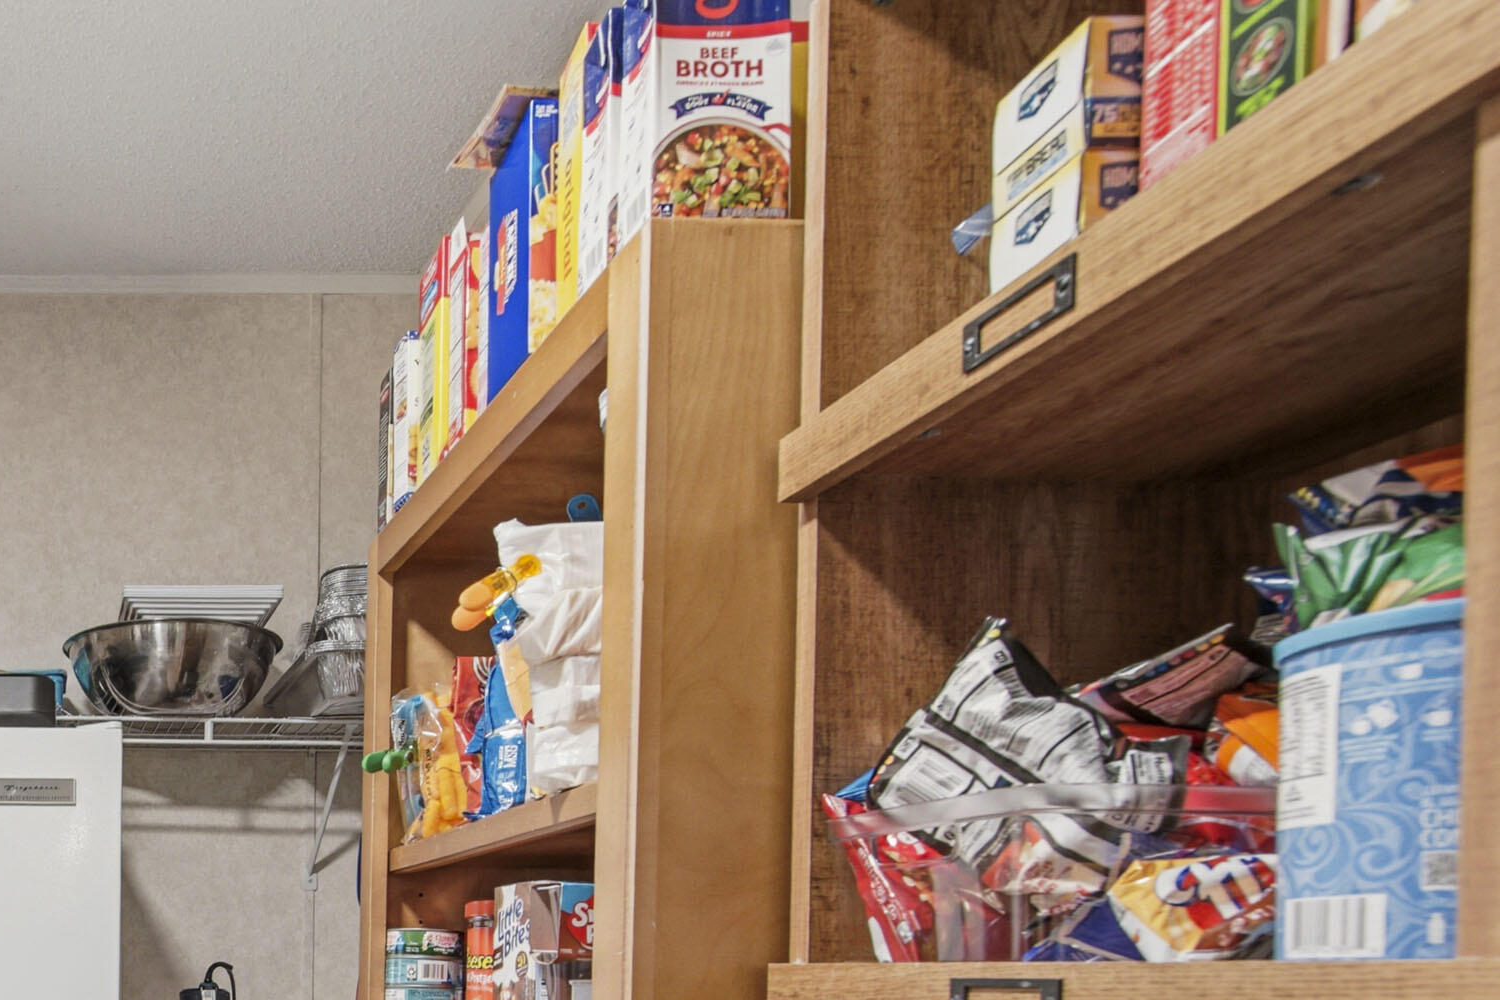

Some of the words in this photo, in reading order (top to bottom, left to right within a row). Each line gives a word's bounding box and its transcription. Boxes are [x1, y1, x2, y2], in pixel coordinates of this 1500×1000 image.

[700, 47, 739, 59] BEEF
[676, 59, 763, 78] BROTH
[497, 897, 524, 943] Little
